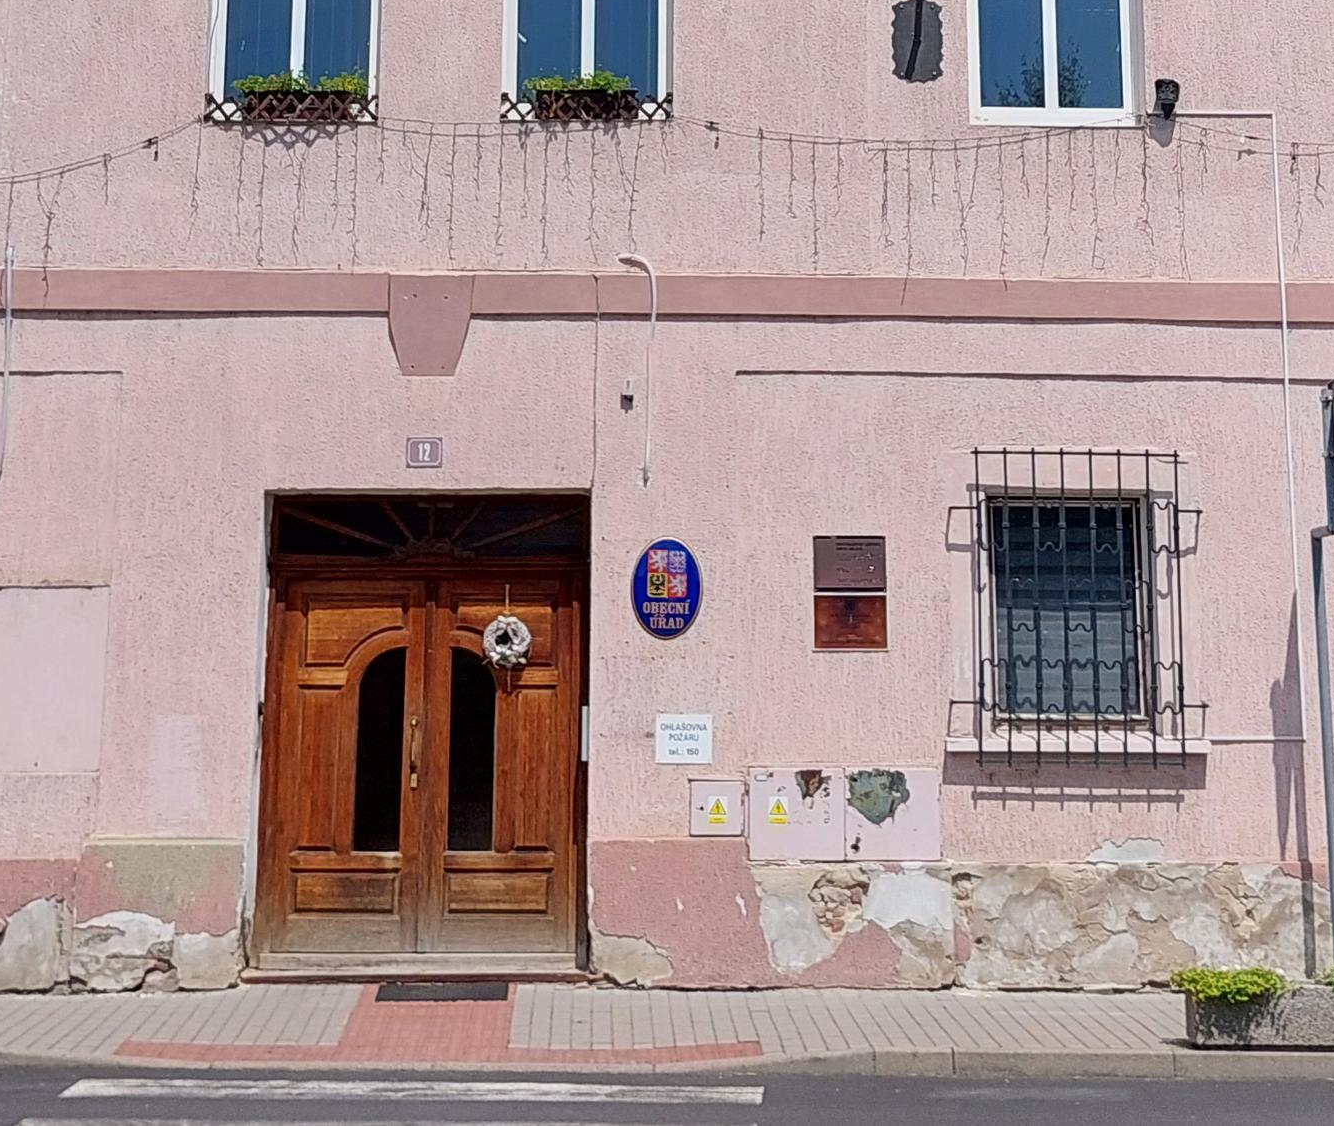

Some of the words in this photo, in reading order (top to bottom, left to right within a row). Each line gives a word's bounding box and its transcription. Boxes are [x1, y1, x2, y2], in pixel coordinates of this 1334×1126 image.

[417, 442, 431, 462] 12
[642, 599, 691, 614] OBECNÍ
[649, 614, 685, 629] ÚŘAD
[659, 721, 708, 731] OHLAŠOVNA
[686, 747, 699, 756] 150
